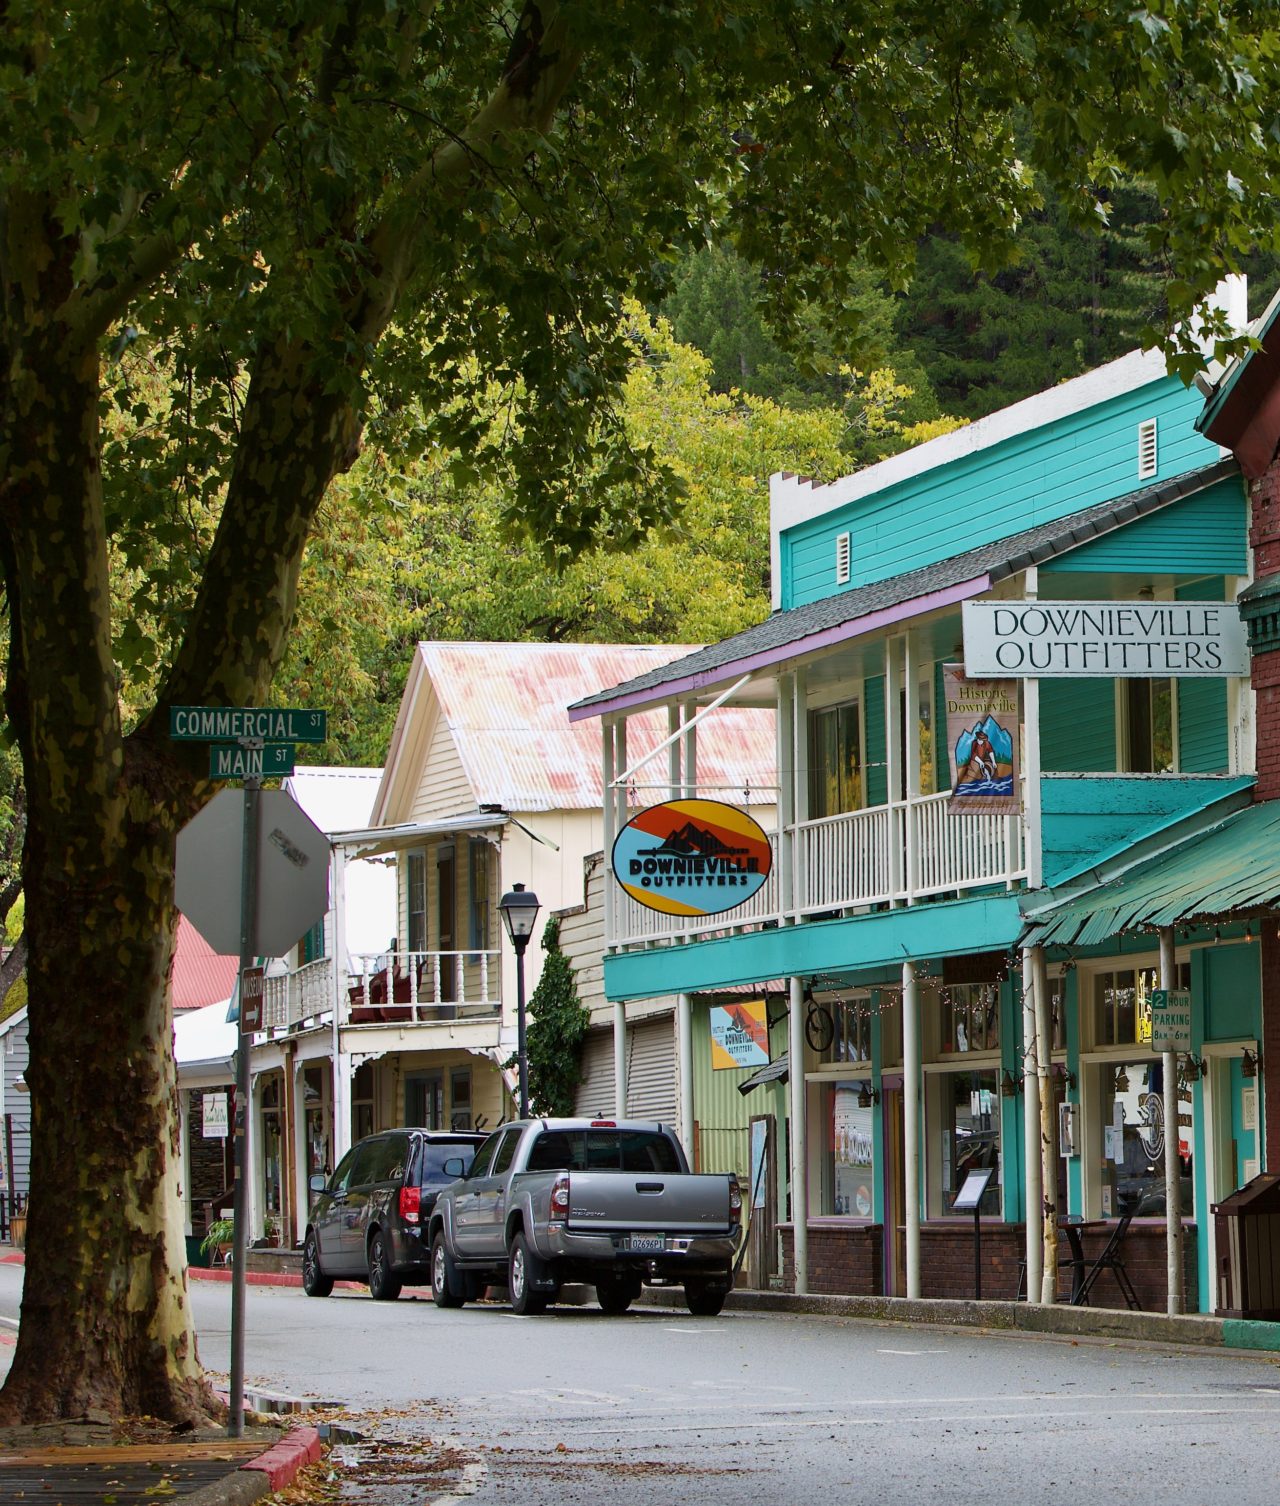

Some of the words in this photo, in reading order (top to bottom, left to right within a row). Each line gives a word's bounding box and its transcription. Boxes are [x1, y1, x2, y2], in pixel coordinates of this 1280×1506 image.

[994, 608, 1221, 636] DOWNIEVILLE
[995, 641, 1222, 669] OUTFITTERS
[959, 687, 1007, 699] Historic
[948, 699, 1016, 713] Downieville
[175, 711, 298, 737] COMMERCIAL
[310, 713, 321, 726] ST
[218, 750, 263, 774] MAIN
[275, 749, 287, 761] ST
[629, 857, 759, 875] DOWNIEVILLE
[640, 875, 748, 887] OUTFITTERS
[1154, 993, 1164, 1007] 2
[1168, 997, 1189, 1006] HOUR
[1154, 1013, 1190, 1026] PARKING
[632, 1241, 662, 1250] 02696P1
